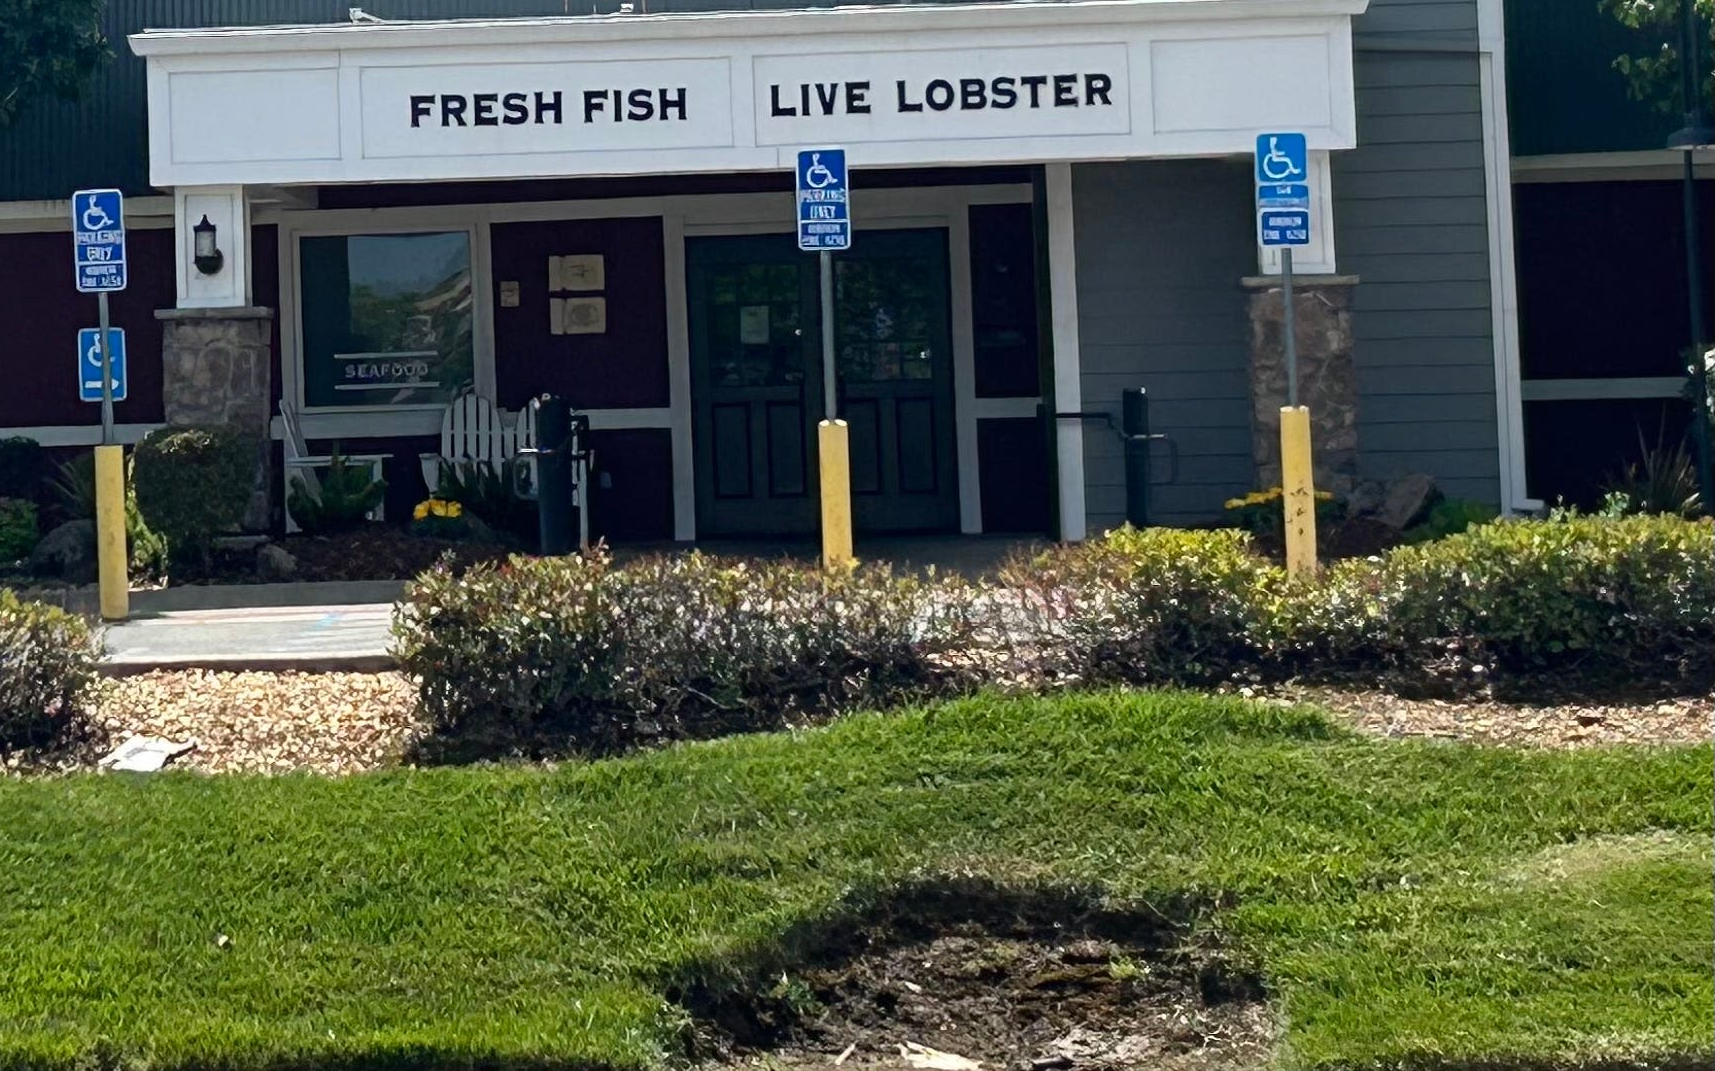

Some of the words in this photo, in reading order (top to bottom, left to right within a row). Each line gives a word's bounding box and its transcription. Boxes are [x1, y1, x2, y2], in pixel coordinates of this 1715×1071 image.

[409, 91, 563, 128] FRESH
[582, 87, 688, 124] FISH
[770, 80, 872, 117] LIVE
[896, 72, 1113, 114] LOBSTER
[344, 362, 429, 379] SEAFOOD
